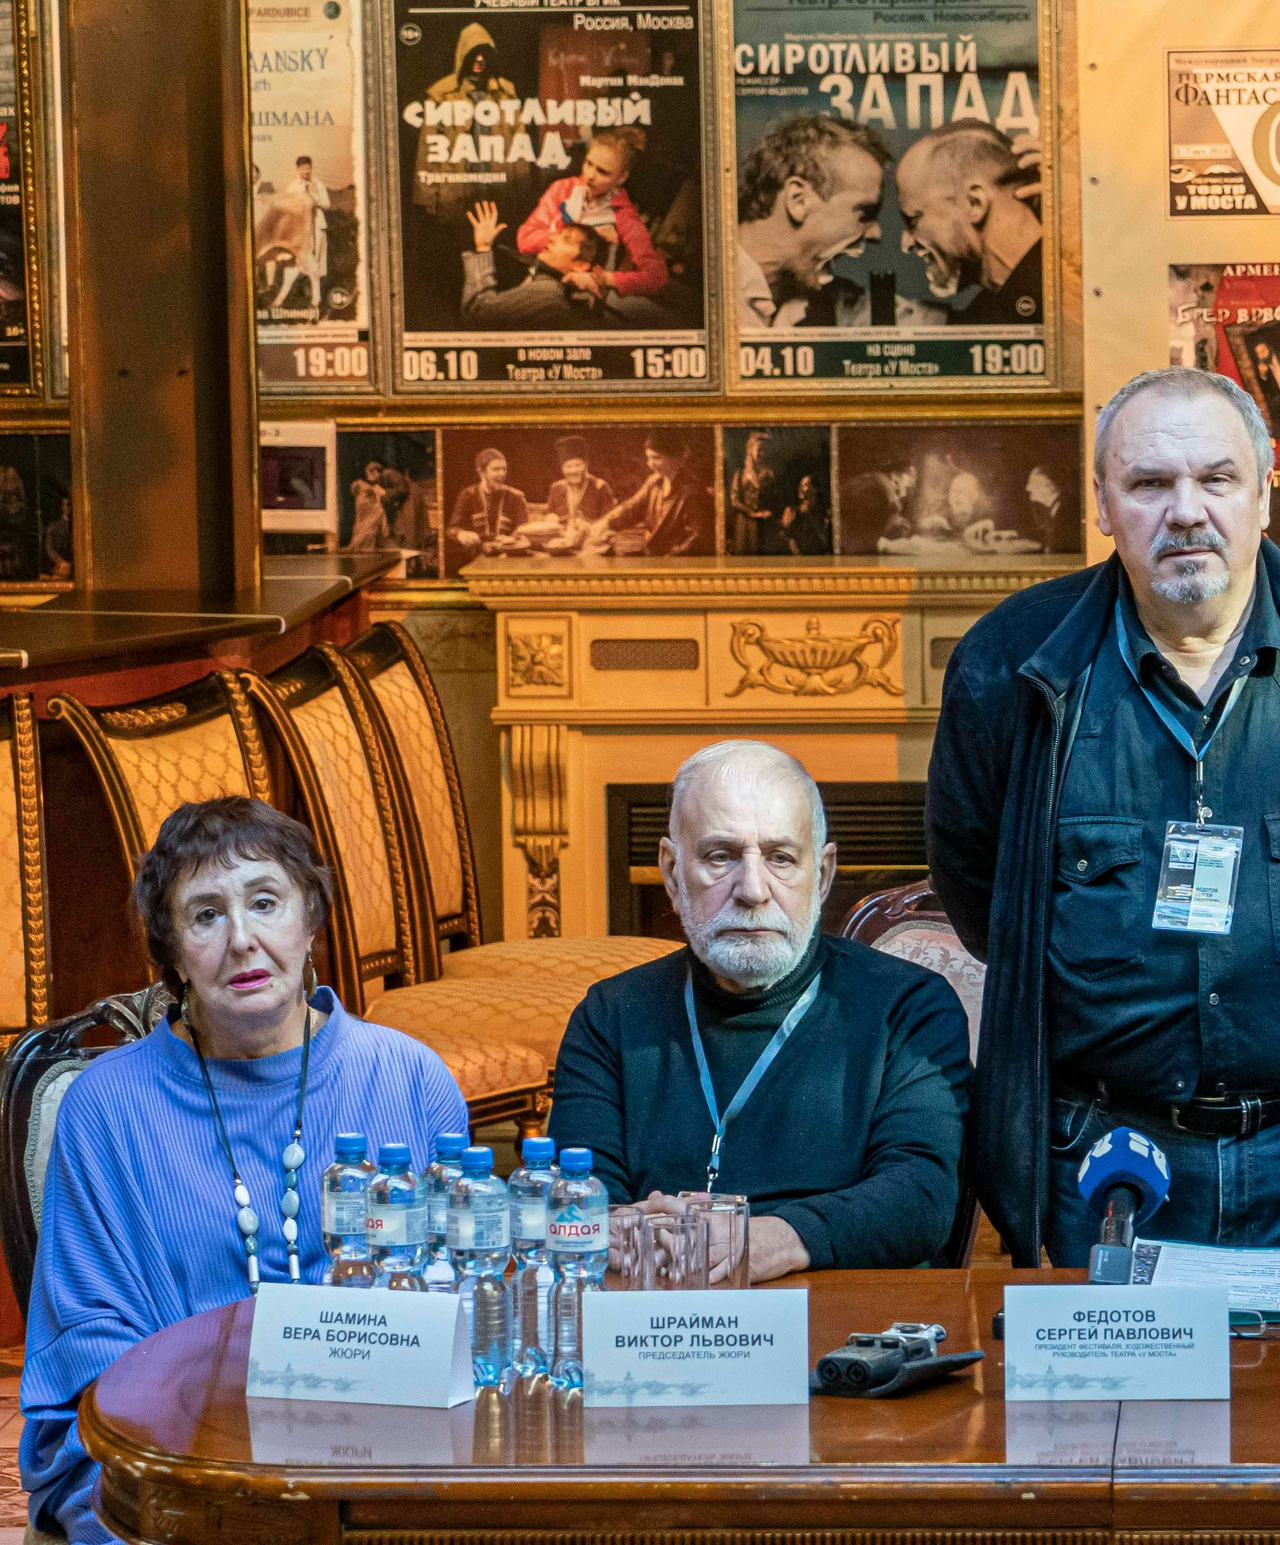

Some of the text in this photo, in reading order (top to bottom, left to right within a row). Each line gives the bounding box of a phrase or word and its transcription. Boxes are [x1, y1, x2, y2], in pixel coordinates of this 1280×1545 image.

[573, 13, 694, 32] Россия, Москва
[734, 33, 978, 75] СИРОТЛИВЫЙ
[402, 92, 652, 128] СИРОТЛИВЫЙ
[818, 71, 1041, 137] ЗАПАД
[426, 131, 572, 169] ЗАПАД
[1190, 194, 1258, 210] МОСТА
[516, 348, 592, 362] в новом зале
[865, 343, 915, 357] на сцене
[969, 343, 1045, 375] 19:00
[294, 347, 368, 378] 19:00
[403, 350, 478, 381] 06.10
[631, 348, 707, 379] 15:00
[740, 346, 815, 377] 04.10
[842, 359, 940, 378] Театра Моста»
[506, 364, 603, 383] Театра Моста»
[319, 1310, 388, 1328] ШАМИНА
[650, 1313, 739, 1330] ШРАЙМАН
[1072, 1309, 1156, 1326] ФЕДОТОВ
[282, 1326, 421, 1348] ВЕРА БОРИСОВНА
[615, 1334, 774, 1349] ВИКТОР ЛЬВОВИЧ
[1035, 1325, 1194, 1342] СЕРГЕЙ ПАВЛОВИЧ
[328, 1346, 371, 1361] ЖЮРИ
[638, 1350, 751, 1361] ПРЕДСЕДАТЕЛЬ ЖЮРИ
[1034, 1342, 1195, 1351] ПРЕЗИДЕНТ ХУДОЖЕСТВЕННЫЙ
[1052, 1350, 1177, 1359] РУКОВОДИТЕЛЬ ТЕАТРА МОСТА»
